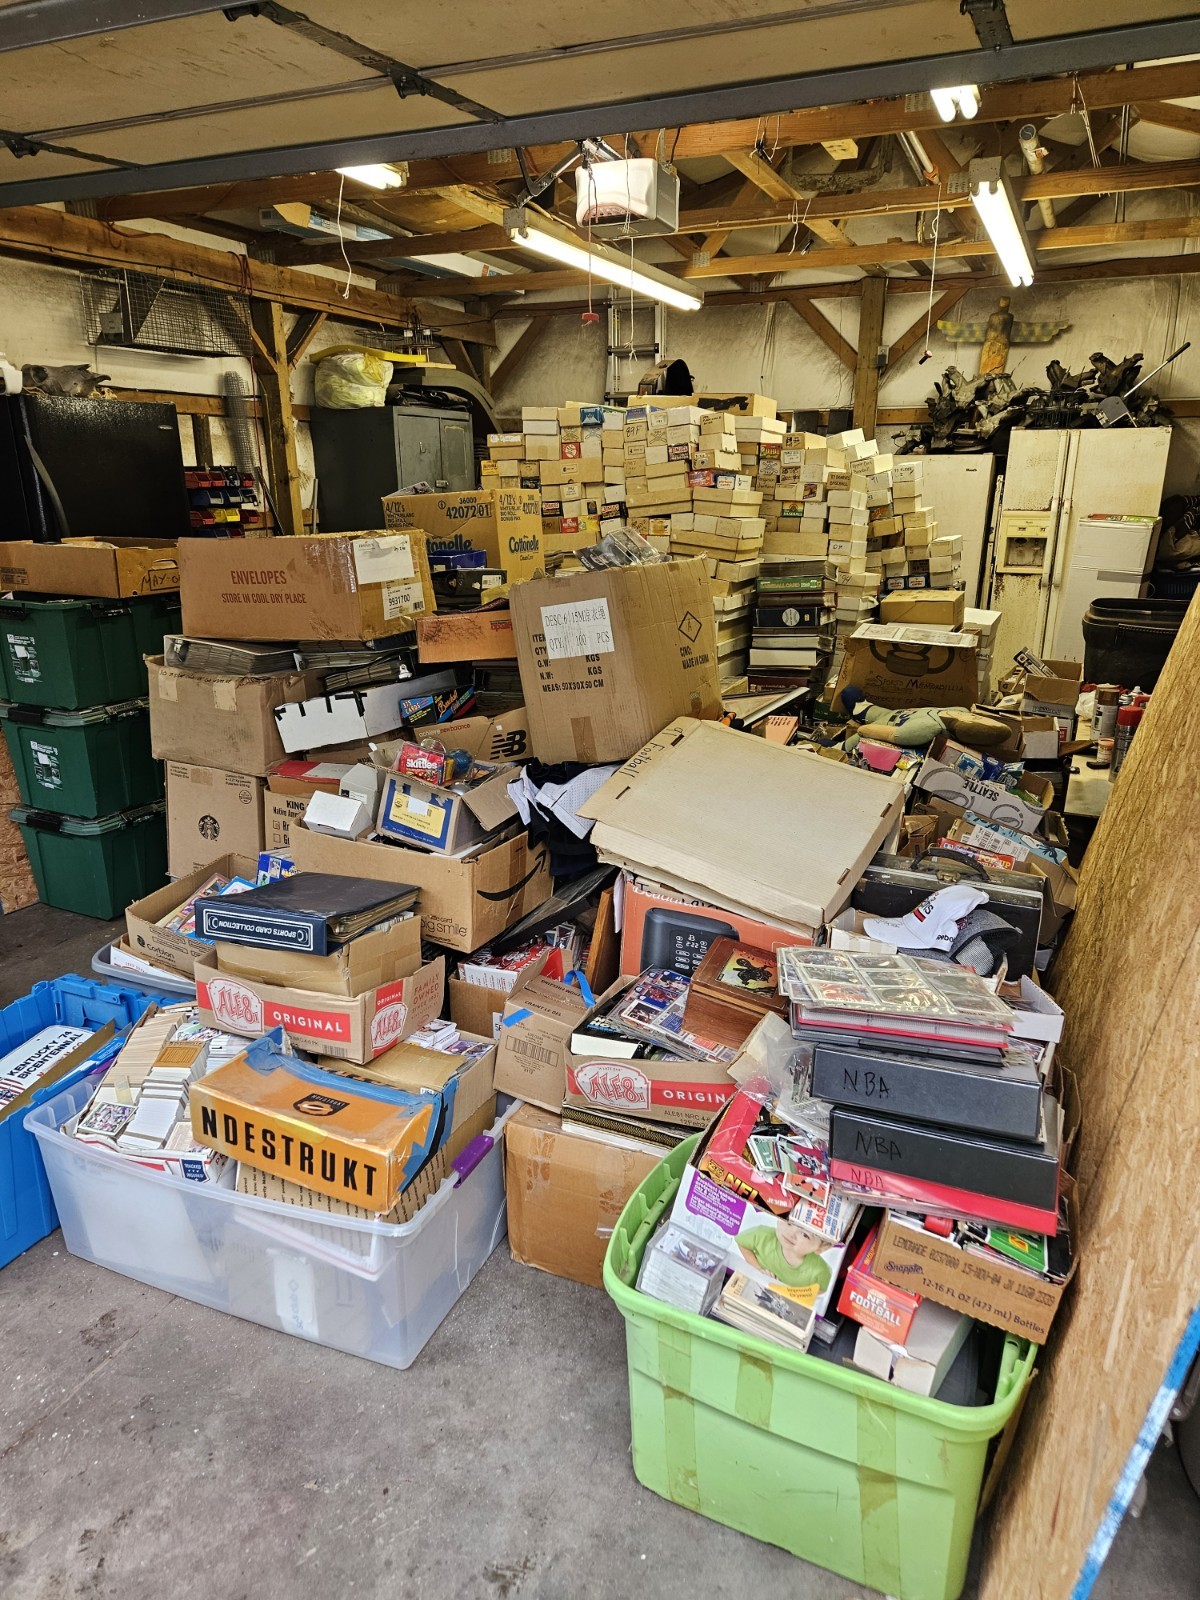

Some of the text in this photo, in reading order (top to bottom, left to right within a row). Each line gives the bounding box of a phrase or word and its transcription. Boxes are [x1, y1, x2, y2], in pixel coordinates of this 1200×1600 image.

[446, 506, 478, 520] 42072
[508, 534, 539, 553] Cottonelle
[231, 570, 287, 585] ENVELOPES
[221, 592, 307, 604] STORE IN COOL DRY PLACE
[585, 653, 601, 663] KGS
[540, 666, 603, 680] N.W: KGS
[593, 678, 604, 688] CM
[405, 758, 439, 770] Skittles
[963, 777, 999, 802] SEATTLE
[286, 800, 305, 811] KING
[218, 920, 253, 933] COLLECTION
[273, 930, 297, 938] SPORTS
[377, 991, 402, 1006] ORIGINAL
[413, 983, 439, 1005] OWNED
[272, 1010, 344, 1034] ORIGINAL
[7, 1040, 59, 1077] KENTUCKY
[17, 1032, 84, 1080] BICENTENNIAL
[842, 1068, 890, 1099] NBA
[663, 1089, 726, 1104] ORIGIN
[201, 1106, 377, 1197] NDESTRUKT
[855, 1131, 902, 1159] NBA
[851, 1168, 884, 1188] NBA
[723, 1171, 761, 1206] NFL
[884, 1260, 924, 1277] Snapple
[849, 1289, 902, 1327] FOOTBALL
[866, 1293, 888, 1309] NFL
[921, 1276, 946, 1293] 12-16
[946, 1285, 956, 1299] FL
[957, 1291, 971, 1303] OZ
[971, 1296, 992, 1313] (473
[1013, 1314, 1046, 1335] Bottles
